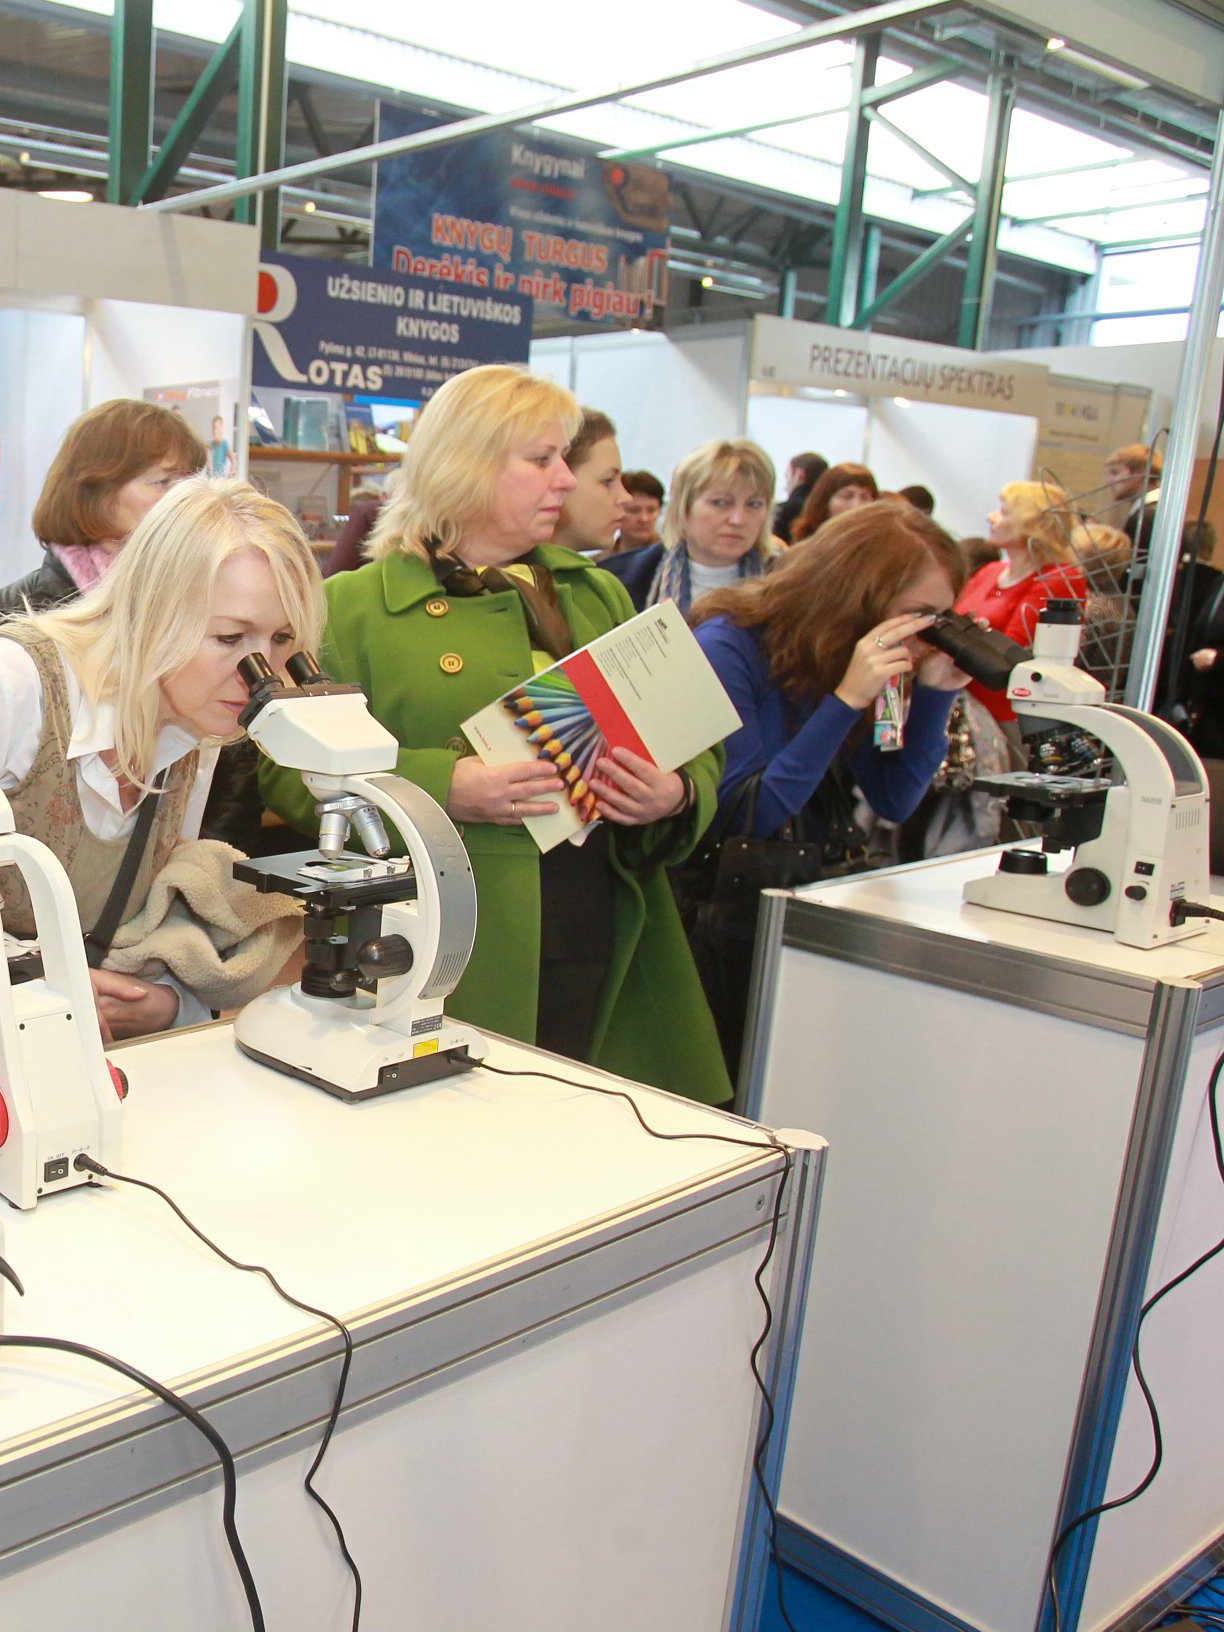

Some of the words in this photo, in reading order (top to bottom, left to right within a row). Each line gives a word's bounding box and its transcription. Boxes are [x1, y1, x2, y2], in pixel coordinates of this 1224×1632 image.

[432, 213, 514, 262] KNYGŲ
[522, 230, 608, 274] TURGUS
[327, 274, 405, 307] UŽSIENIO
[408, 287, 425, 310] IR
[428, 291, 522, 326] LIETUVIŠKOS
[396, 315, 460, 345] KNYGOS
[809, 343, 936, 395] PREZENTACIJŲ
[938, 364, 1015, 401] SPEKTRAS
